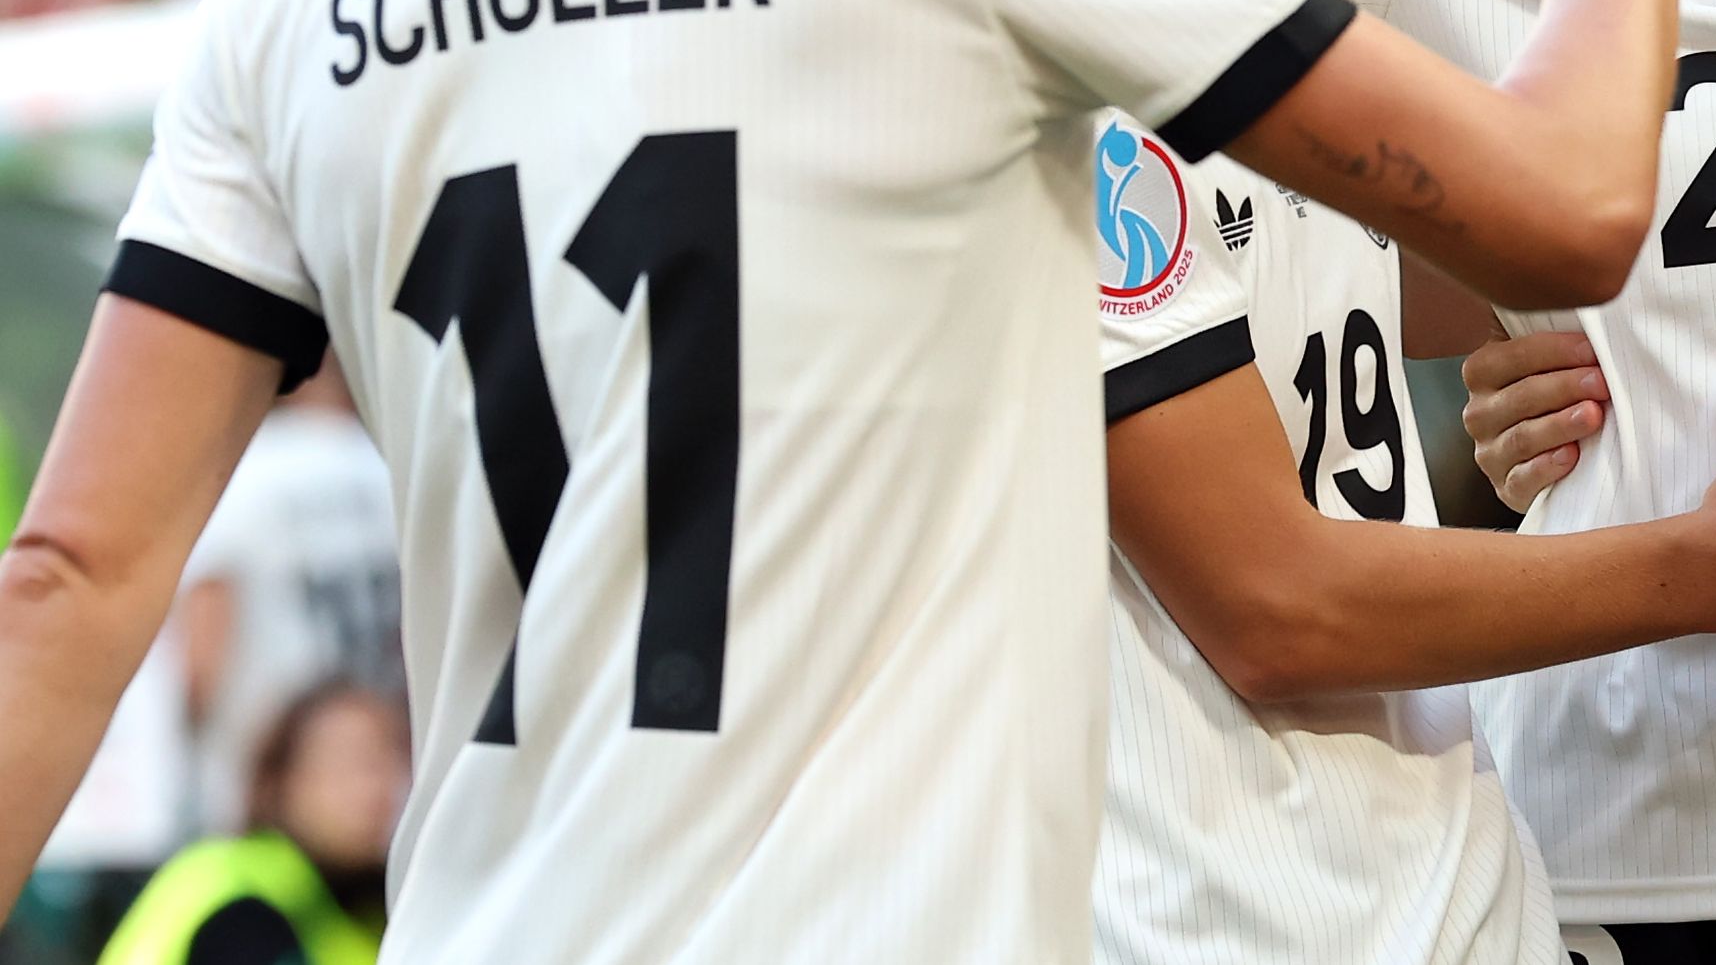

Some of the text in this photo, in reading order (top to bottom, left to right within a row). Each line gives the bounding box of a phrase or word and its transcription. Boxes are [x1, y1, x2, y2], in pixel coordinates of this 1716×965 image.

[1173, 249, 1194, 286] 2025
[392, 129, 741, 746] 11
[1293, 308, 1406, 524] 19
